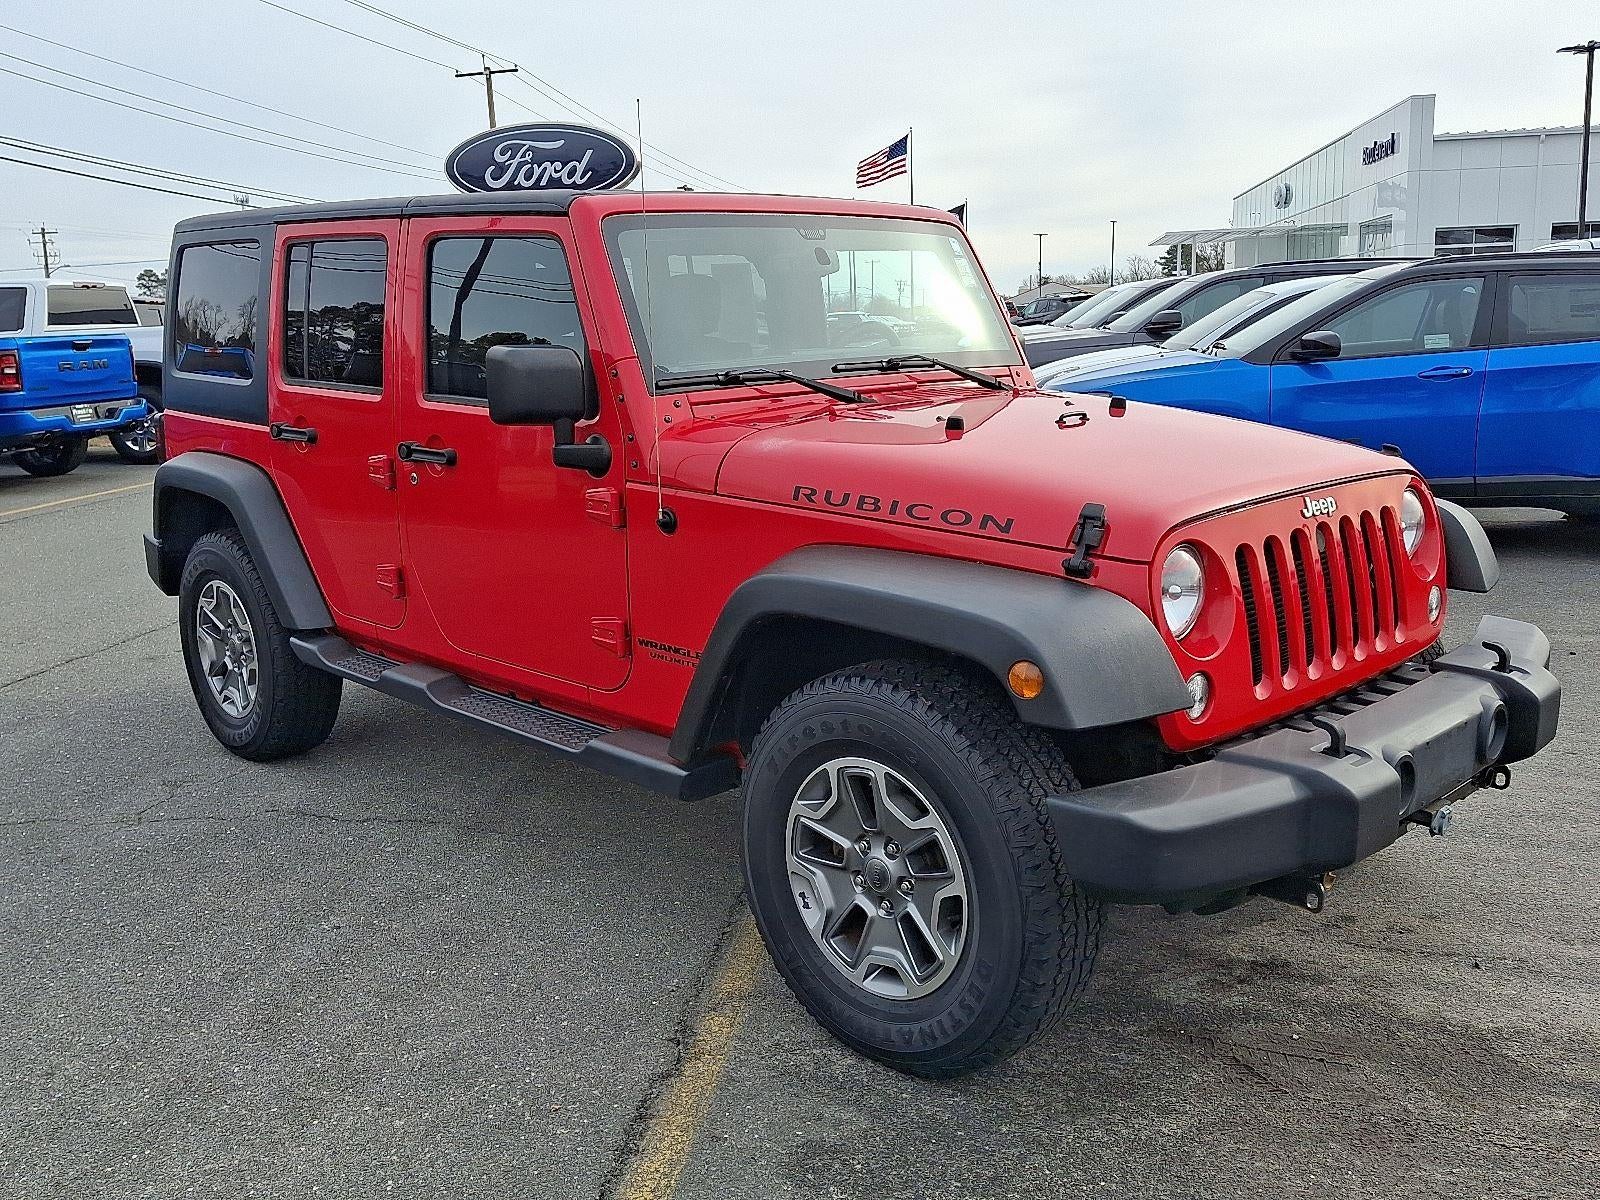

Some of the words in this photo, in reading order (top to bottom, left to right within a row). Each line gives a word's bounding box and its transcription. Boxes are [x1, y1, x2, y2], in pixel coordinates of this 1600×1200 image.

[484, 139, 594, 189] Ford
[58, 359, 109, 372] RAM
[792, 485, 1015, 535] RUBICON
[1302, 496, 1337, 518] Jeep
